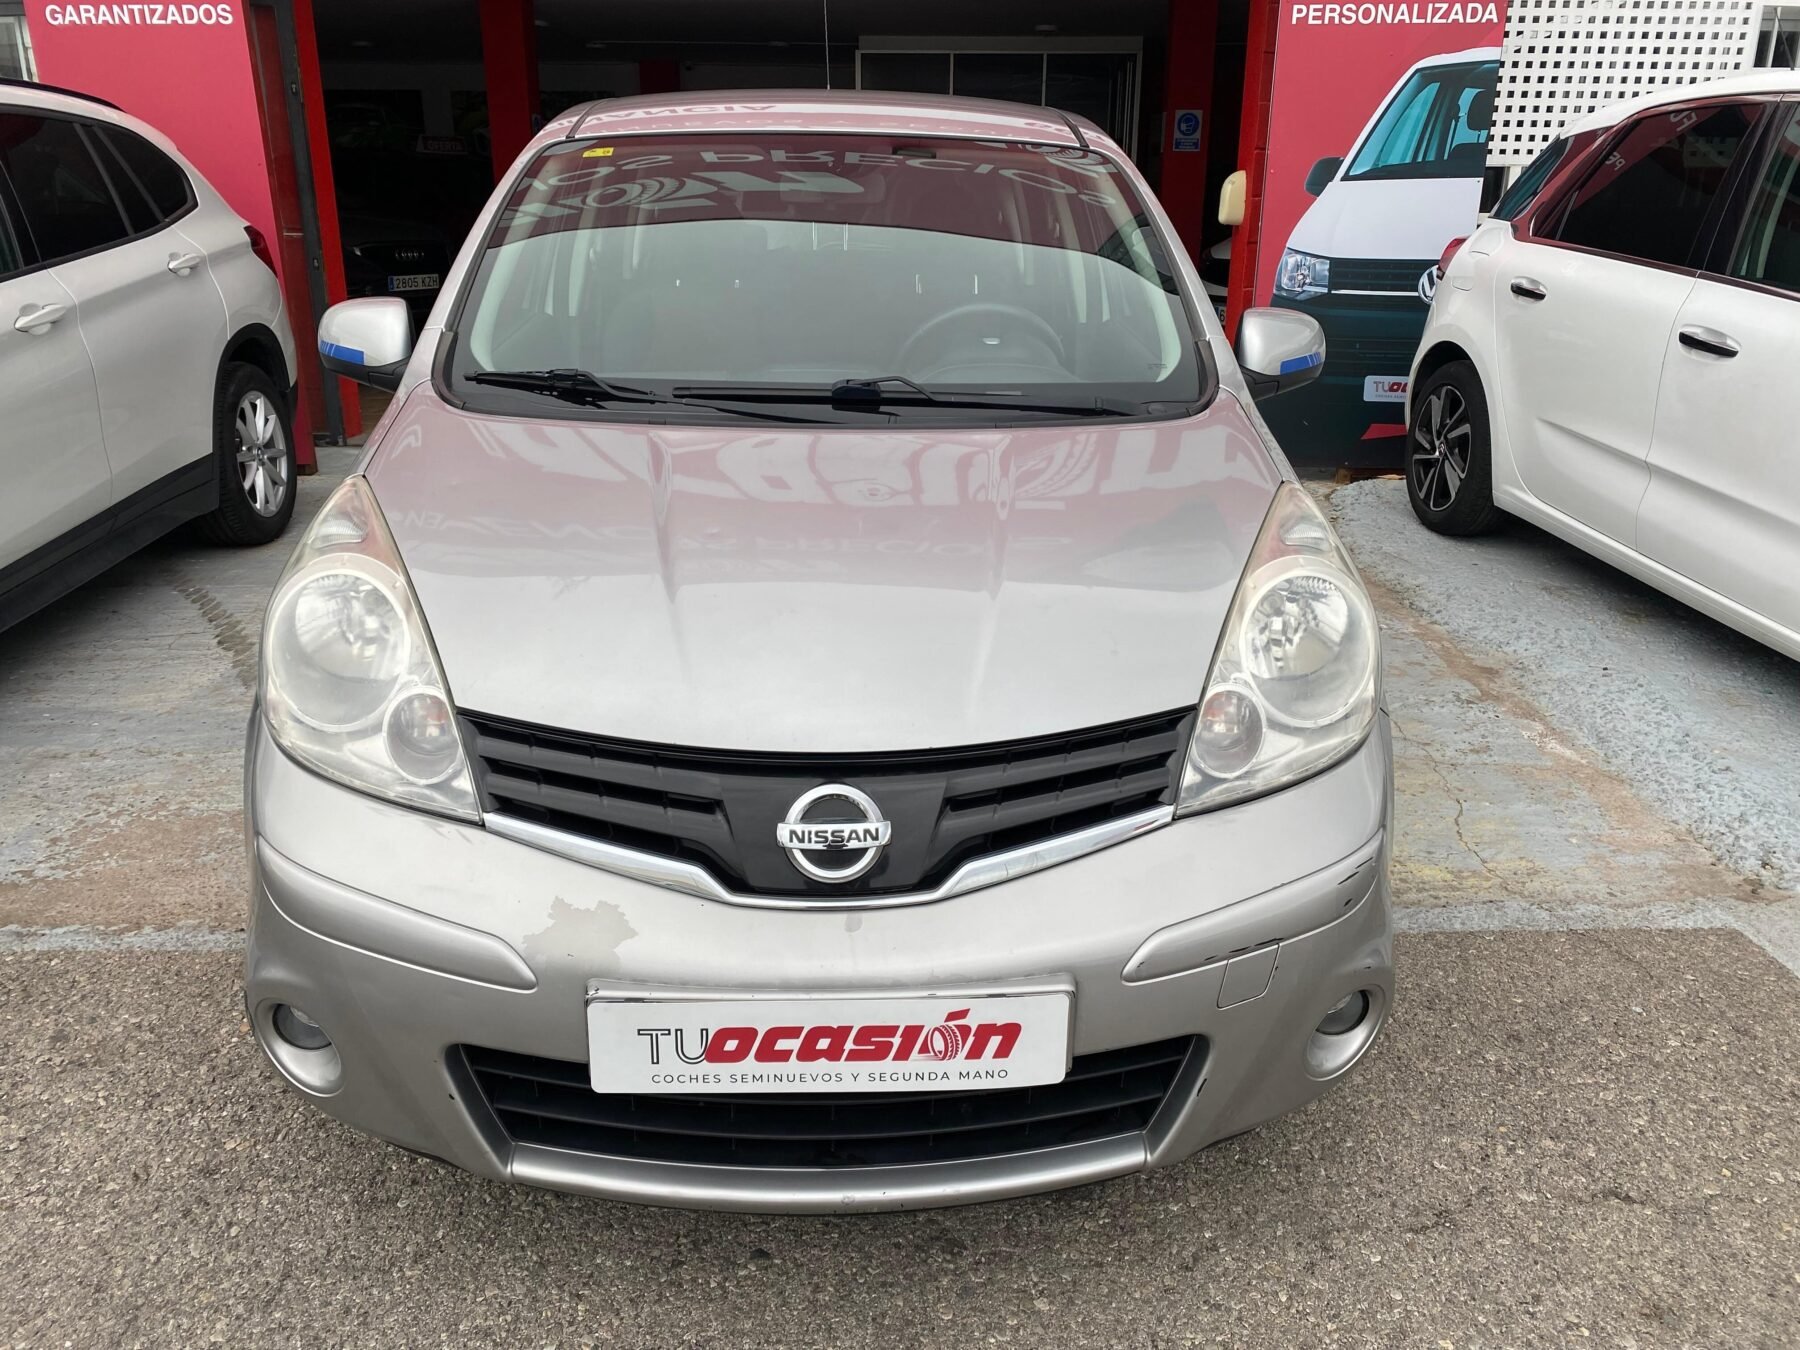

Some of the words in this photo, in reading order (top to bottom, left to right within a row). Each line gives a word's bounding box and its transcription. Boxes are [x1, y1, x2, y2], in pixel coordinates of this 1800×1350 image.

[46, 4, 233, 25] GARANTIZADOS
[1291, 3, 1498, 24] PERSONALIZADA
[396, 277, 419, 289] 2805
[421, 276, 438, 287] KZH
[788, 827, 880, 845] NISSAN
[651, 1074, 722, 1084] COCHES
[729, 1073, 843, 1084] SEMINUEVOS
[850, 1072, 860, 1083] Y
[867, 1071, 951, 1082] SEGUNDA
[958, 1069, 1009, 1081] MANO
